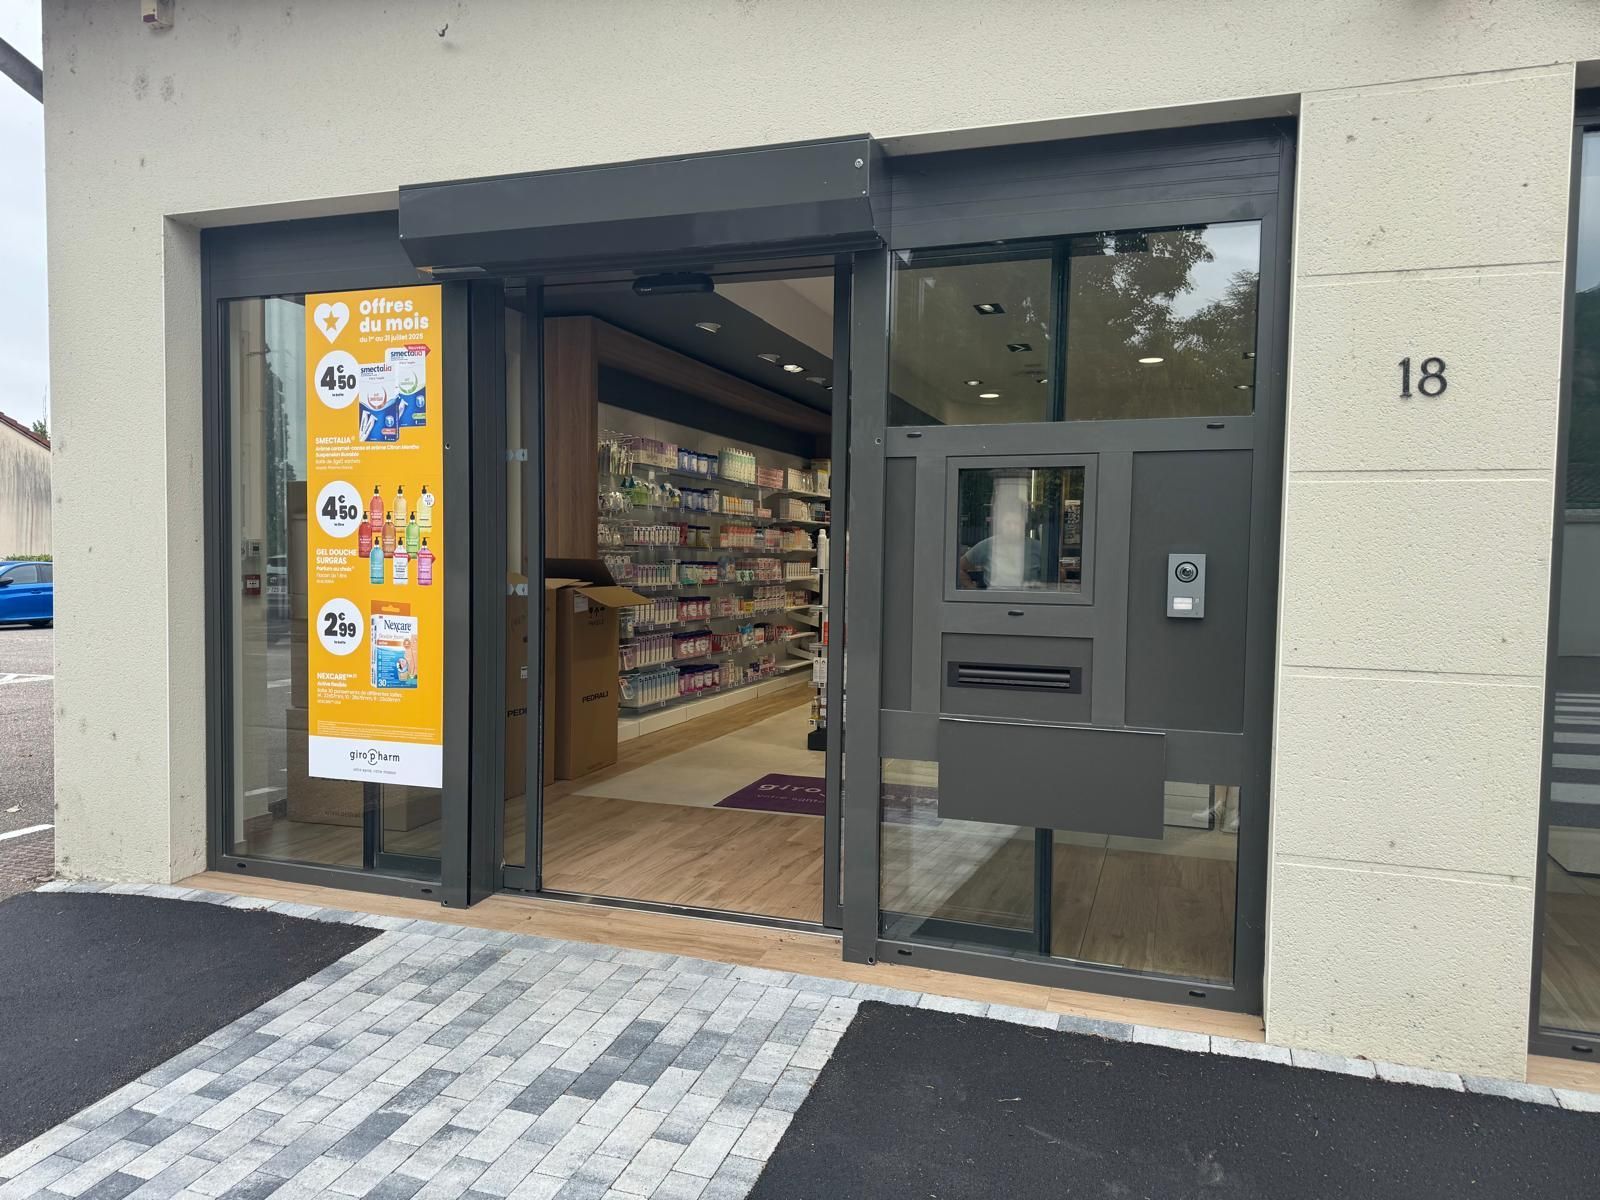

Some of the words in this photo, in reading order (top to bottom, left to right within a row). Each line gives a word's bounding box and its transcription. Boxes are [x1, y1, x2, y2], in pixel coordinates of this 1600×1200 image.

[360, 298, 413, 314] Offres
[360, 317, 381, 332] du
[386, 312, 428, 331] mois
[361, 364, 391, 373] smectalia
[1399, 357, 1447, 398] 18
[384, 620, 411, 632] Nexcare
[378, 679, 387, 687] 30
[582, 691, 609, 703] PEDRALI
